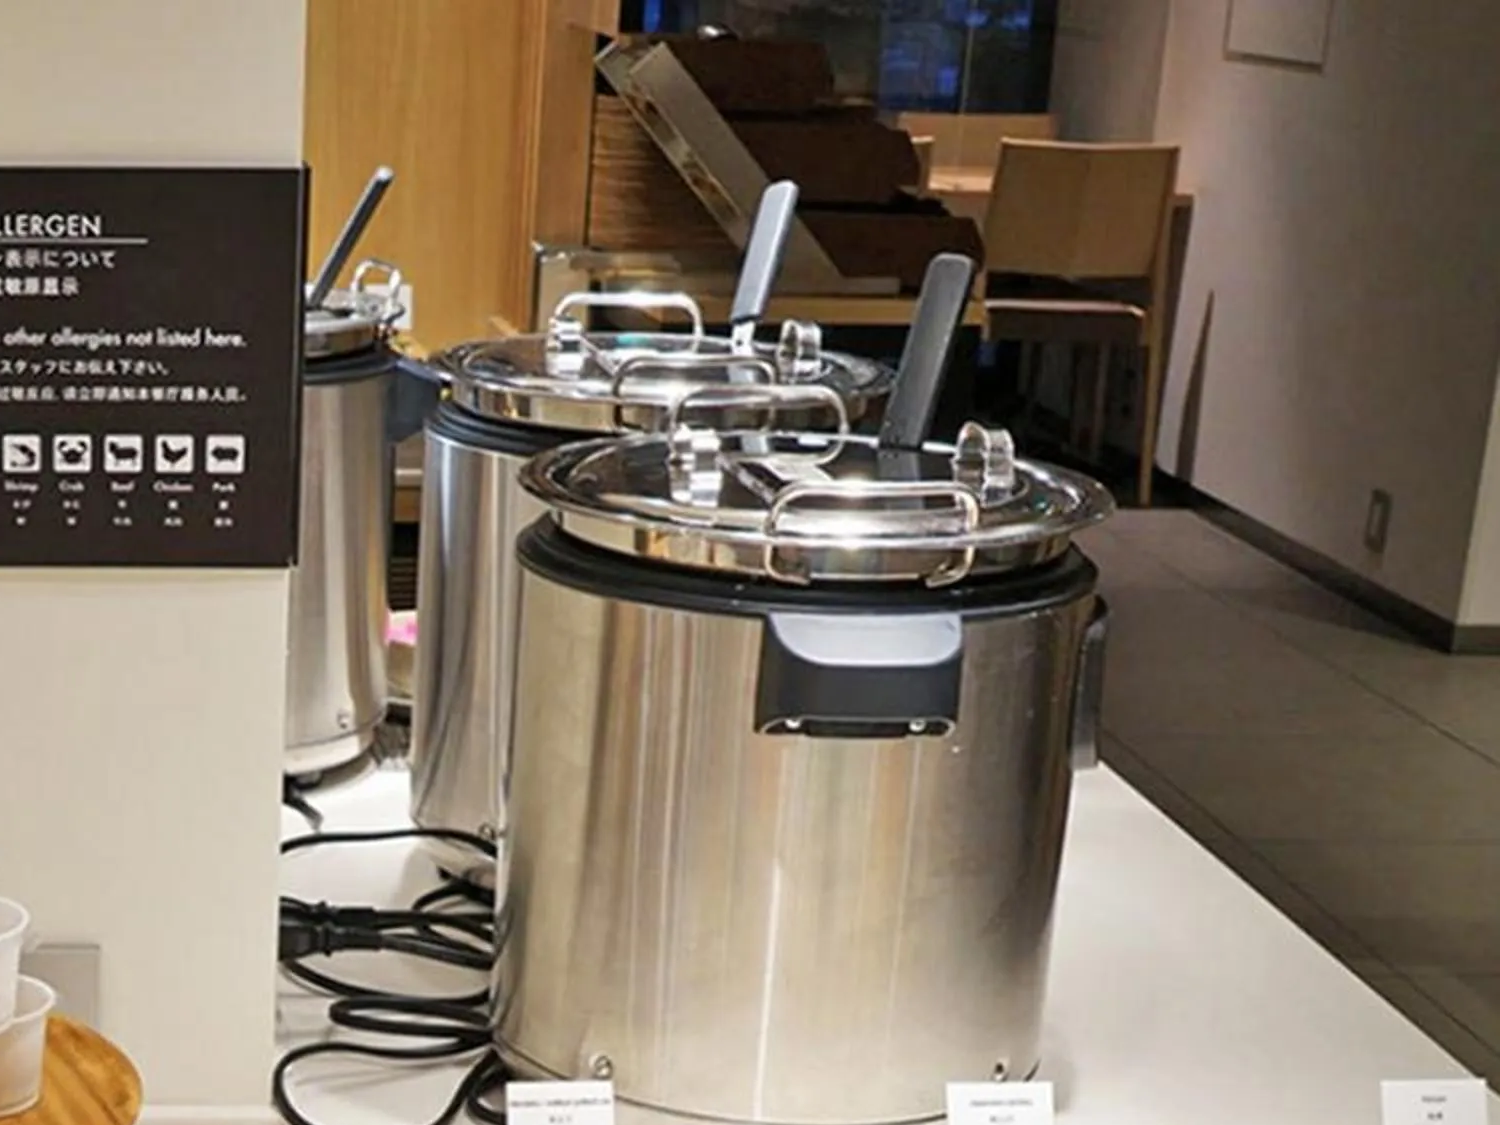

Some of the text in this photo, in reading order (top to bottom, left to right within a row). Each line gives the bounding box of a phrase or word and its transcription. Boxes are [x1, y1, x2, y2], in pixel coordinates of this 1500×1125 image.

[3, 327, 47, 346] other
[51, 327, 122, 350] allergies
[125, 329, 153, 346] not
[156, 327, 201, 346] listed
[204, 327, 247, 346] here.
